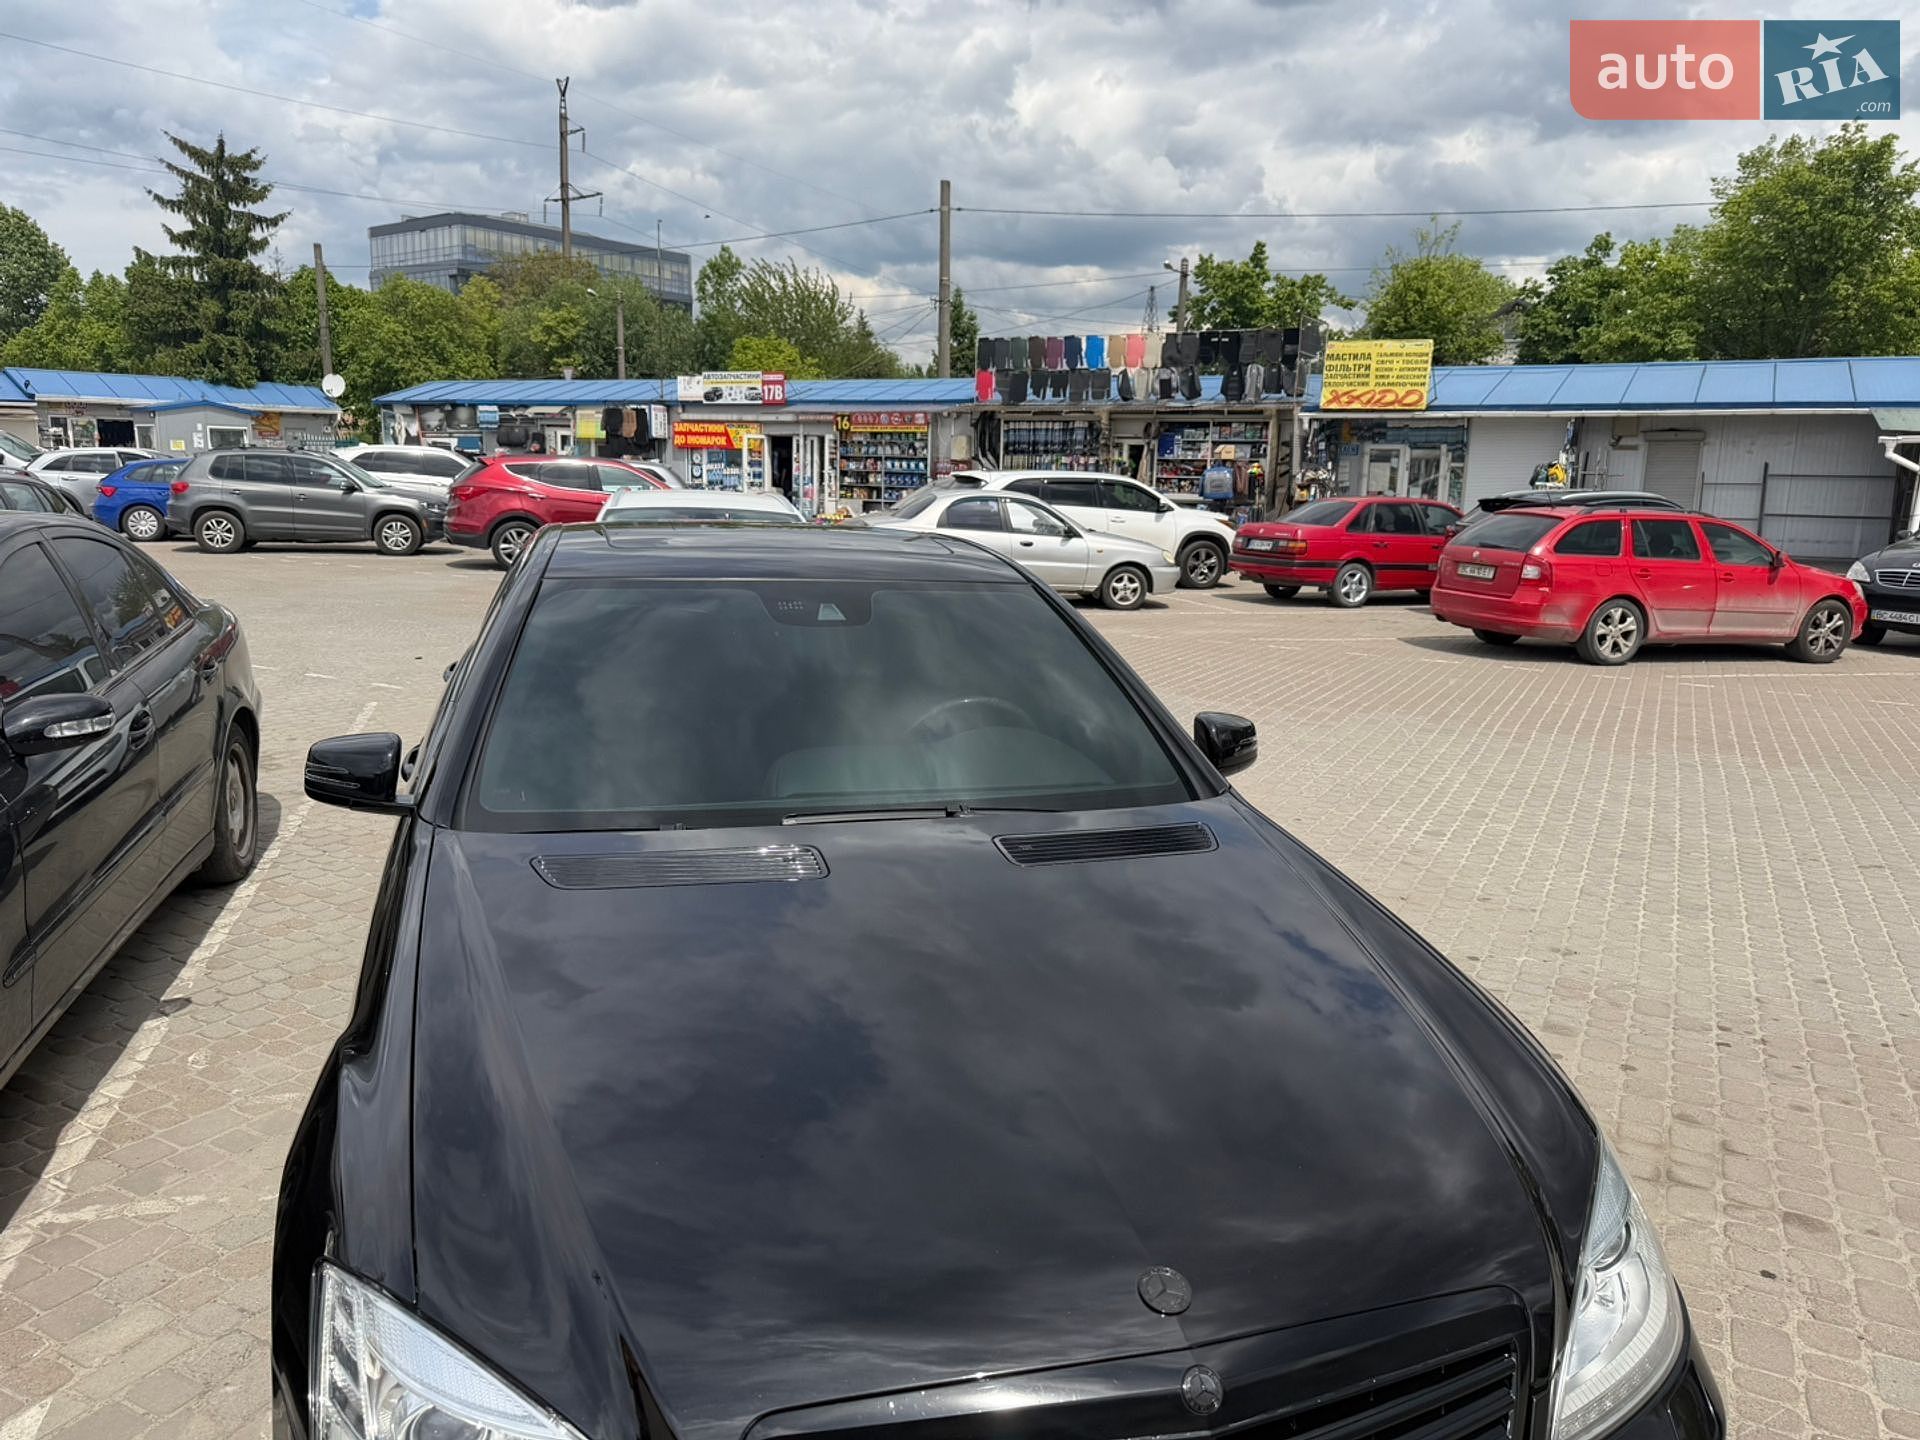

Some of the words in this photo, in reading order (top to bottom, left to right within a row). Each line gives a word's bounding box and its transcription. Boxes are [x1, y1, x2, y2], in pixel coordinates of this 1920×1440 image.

[1326, 352, 1372, 361] МАСТИЛА
[1325, 363, 1371, 372] ФІЛЬТРИ
[837, 415, 850, 430] 16
[674, 423, 726, 433] ЗАПЧАСТИНИ
[674, 435, 686, 445] ДО
